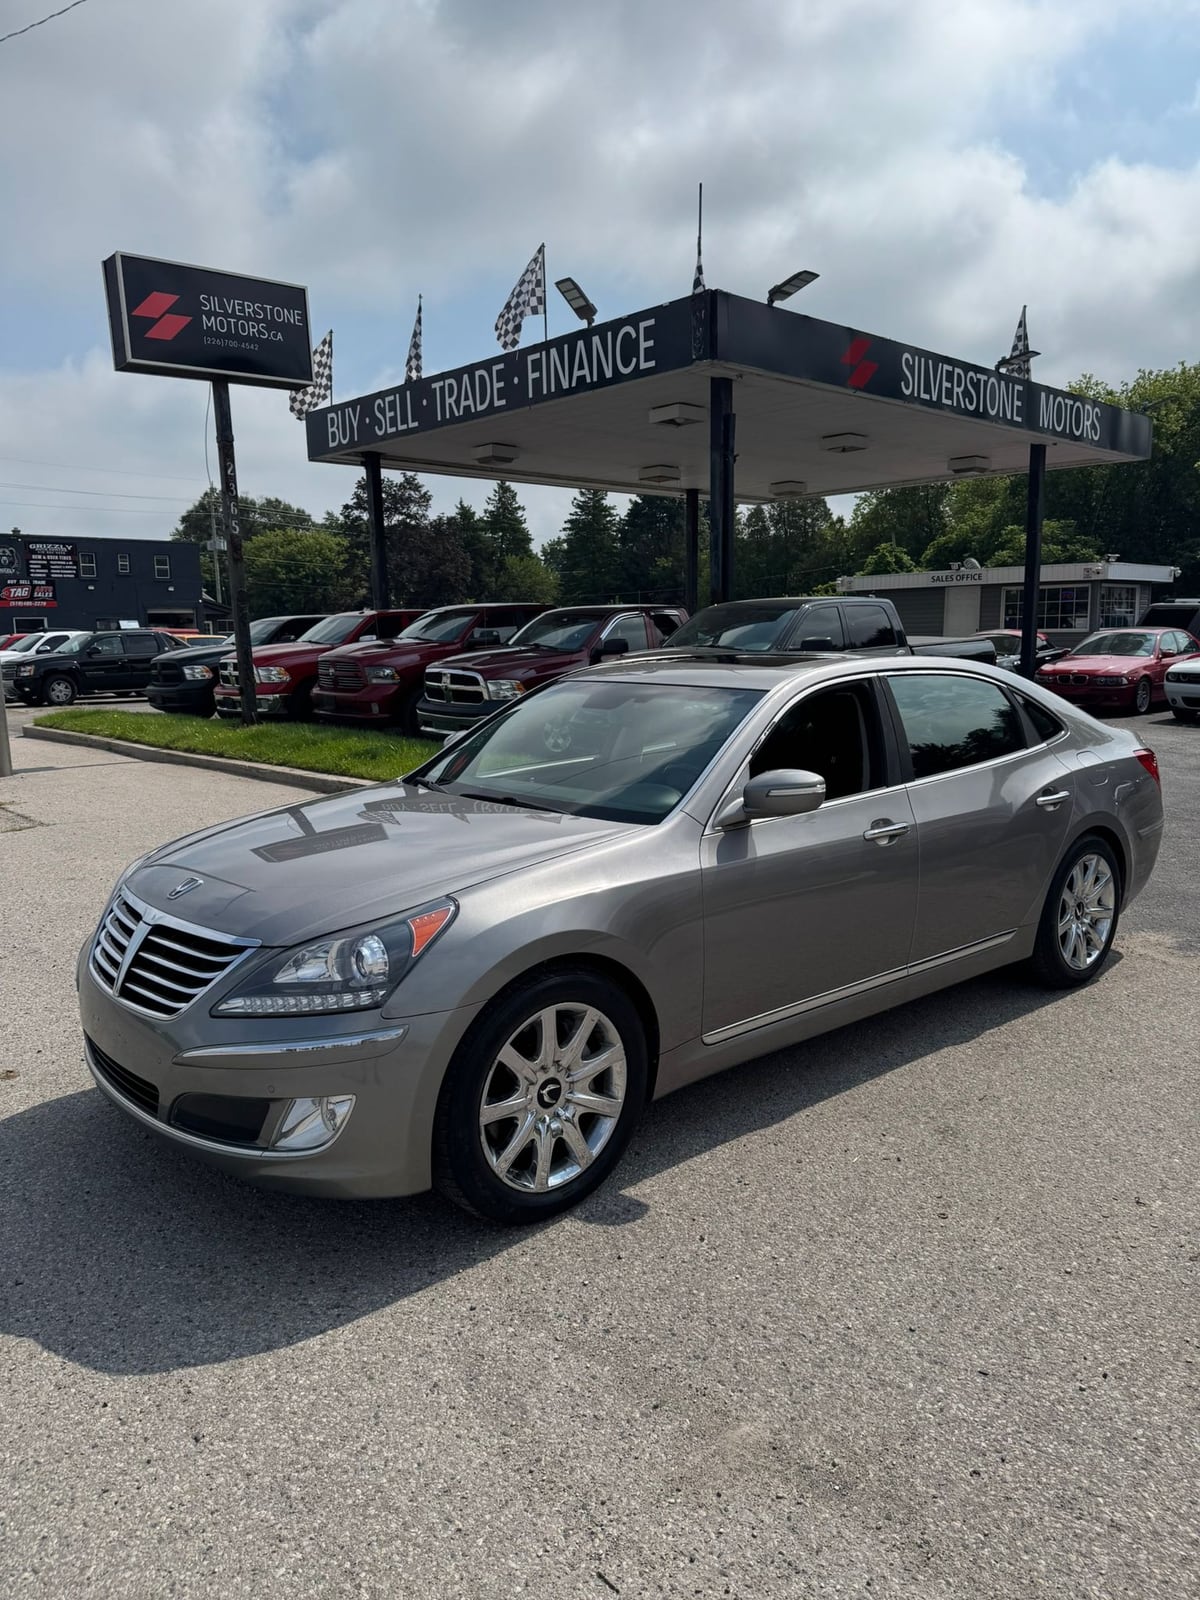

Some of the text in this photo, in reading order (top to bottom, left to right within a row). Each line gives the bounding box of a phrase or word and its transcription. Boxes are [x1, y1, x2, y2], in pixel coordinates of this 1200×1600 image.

[199, 293, 304, 327] SILVERSTONE
[327, 318, 656, 448] BUY SELL TRADE FINANCE
[900, 352, 1101, 441] SILVERSTONE MOTORS
[29, 543, 73, 551] GRIZZLY
[930, 572, 983, 584] SALES OFFICE
[10, 588, 30, 598] TAG
